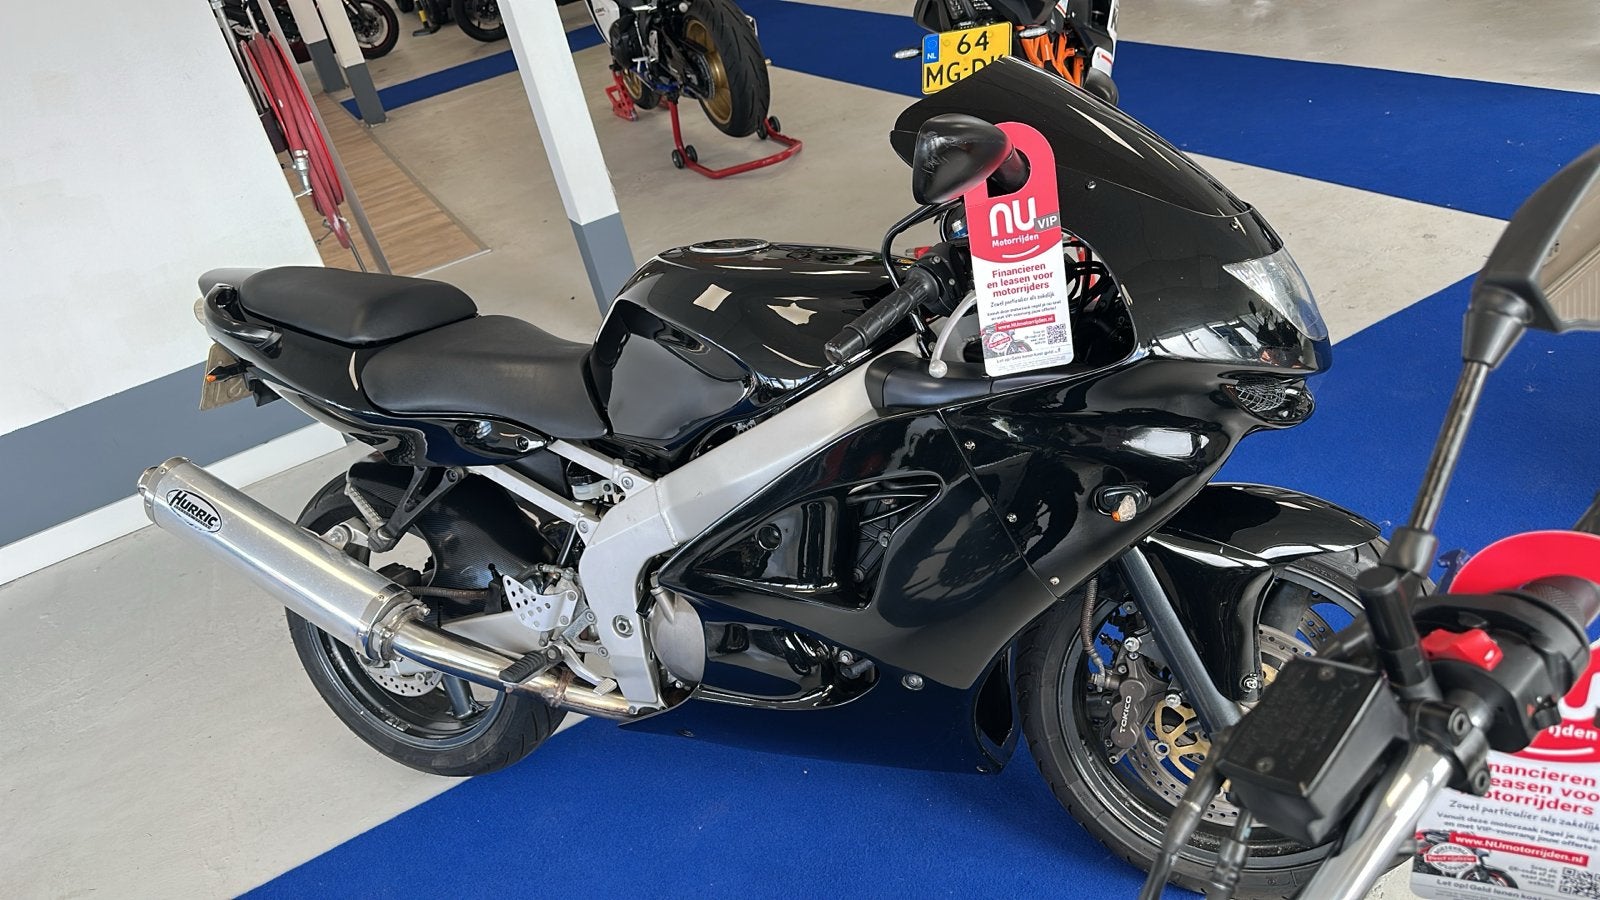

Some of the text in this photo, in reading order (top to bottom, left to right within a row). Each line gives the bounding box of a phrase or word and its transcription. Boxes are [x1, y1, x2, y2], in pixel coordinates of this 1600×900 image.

[956, 31, 989, 55] 64
[927, 52, 937, 60] NL
[1037, 215, 1058, 229] VIP
[991, 233, 1039, 248] Motorrijden
[987, 271, 1054, 289] en leasen voor
[992, 263, 1046, 279] Financieren
[992, 282, 1050, 298] motorrijders
[168, 490, 219, 527] HURRIC
[1120, 695, 1132, 733] TOKICO
[1488, 763, 1597, 788] nancieren
[1490, 777, 1600, 802] easen voo
[1449, 800, 1480, 811] Zowel
[1481, 806, 1539, 821] particulier
[1540, 815, 1557, 824] als
[1483, 789, 1595, 815] otorrijders
[1437, 811, 1465, 821] Vanuit
[1454, 836, 1585, 864] www.NUmotorrijden.nl
